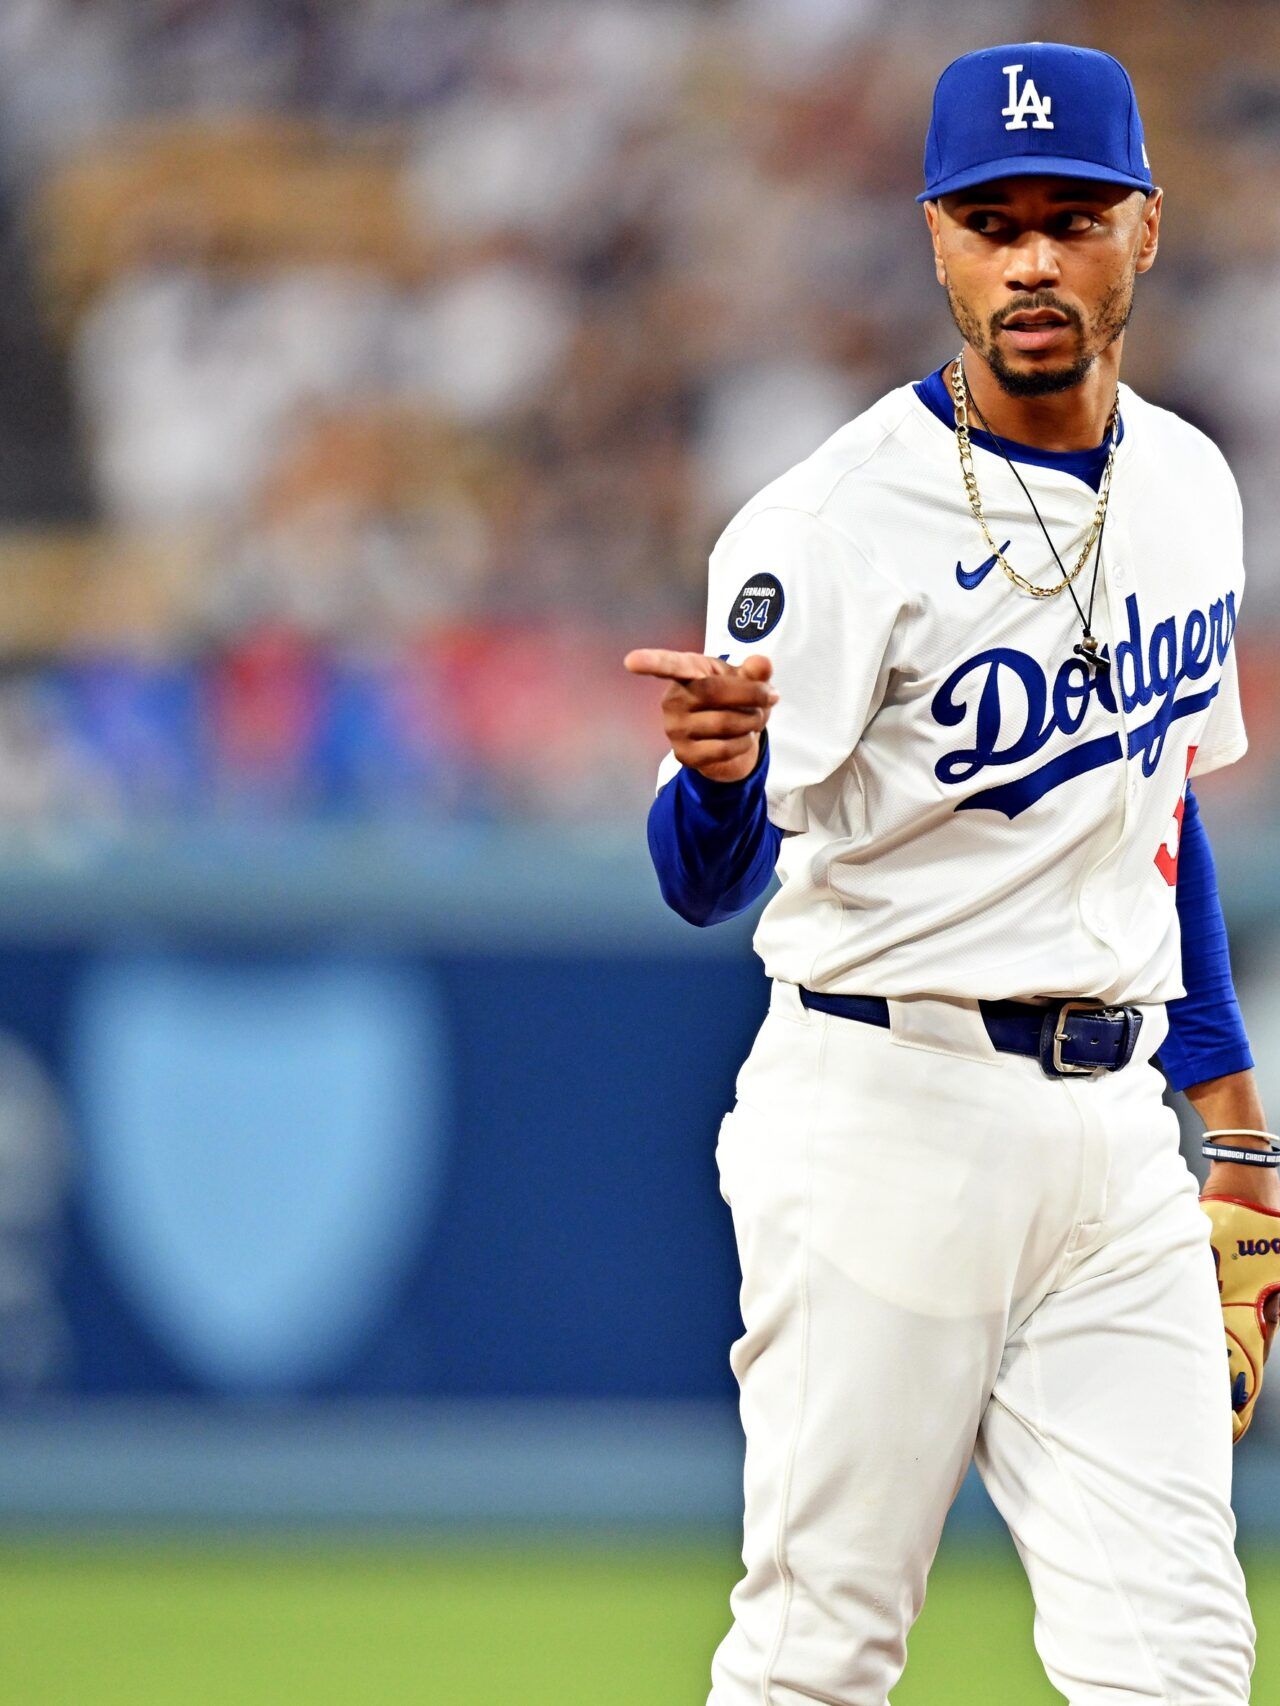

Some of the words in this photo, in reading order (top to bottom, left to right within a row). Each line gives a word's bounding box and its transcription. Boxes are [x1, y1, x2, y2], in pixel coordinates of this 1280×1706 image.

[1001, 64, 1054, 130] LA
[742, 587, 776, 597] FERNANDO
[735, 598, 770, 630] 34
[931, 590, 1236, 784] Dodgers
[1217, 1149, 1244, 1159] THROUGH
[1245, 1152, 1266, 1162] CHRIST
